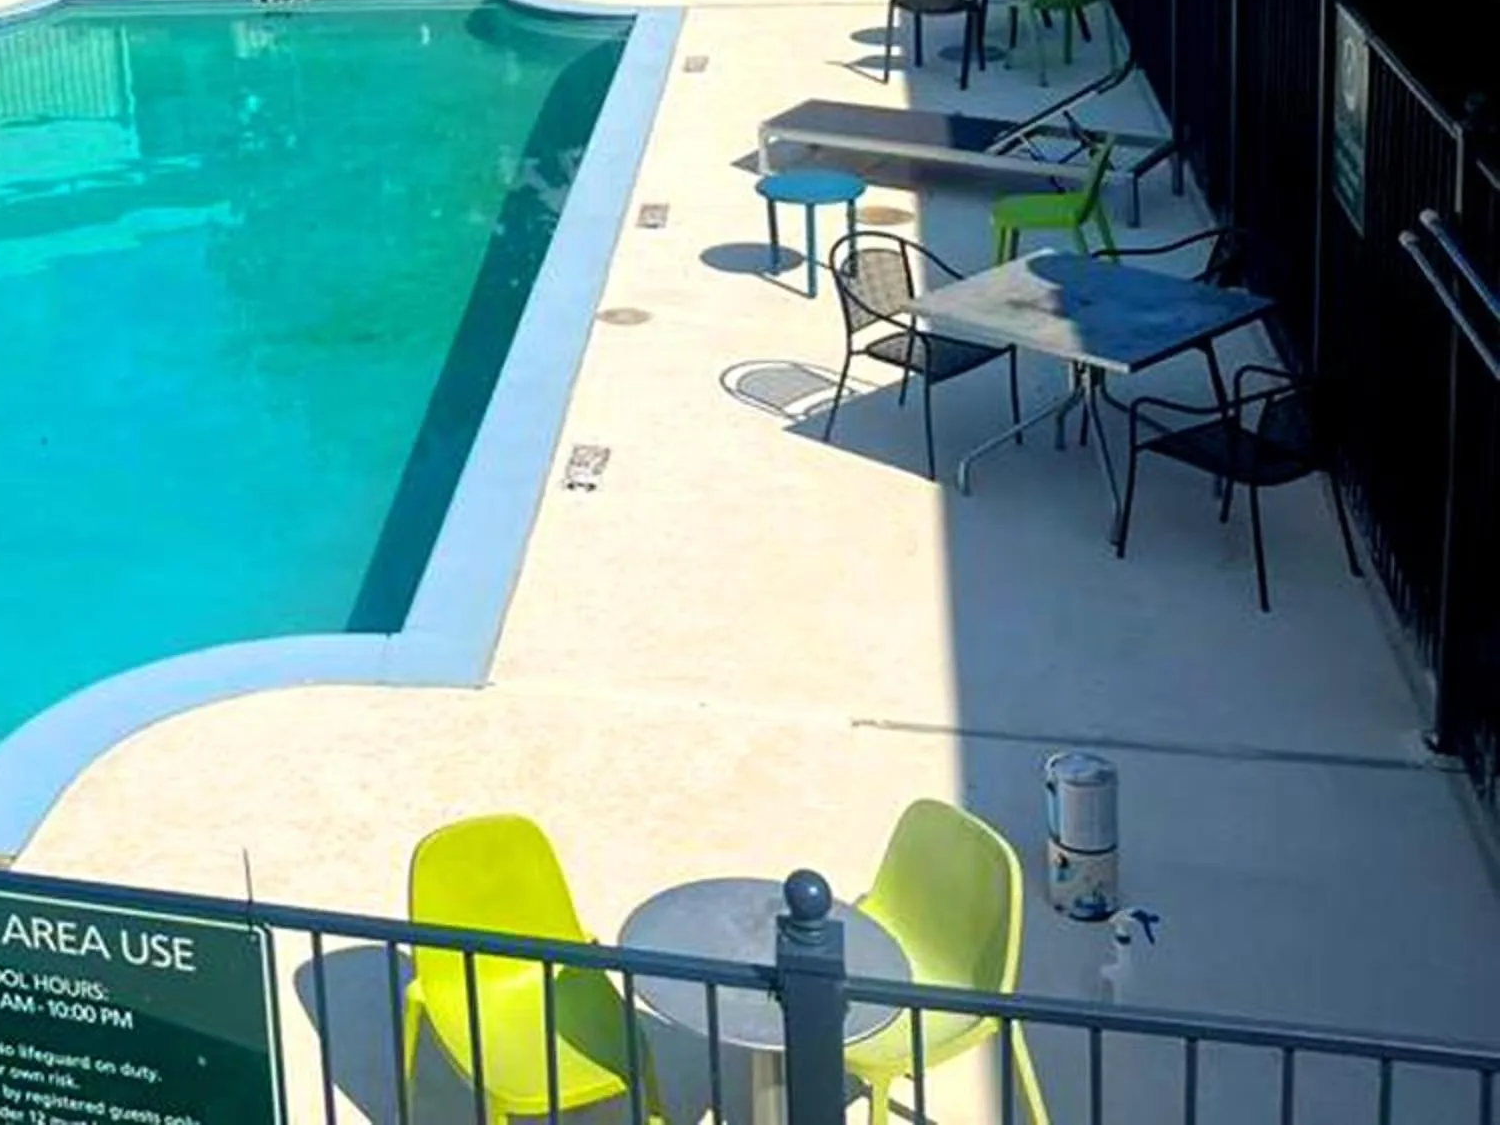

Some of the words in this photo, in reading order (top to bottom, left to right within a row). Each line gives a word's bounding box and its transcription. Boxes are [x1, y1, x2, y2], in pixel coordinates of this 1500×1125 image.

[2, 913, 112, 962] AREA
[120, 929, 197, 972] USE
[33, 974, 110, 1002] HOURS:
[0, 992, 36, 1014] AM
[47, 998, 98, 1024] 10:00
[100, 1007, 134, 1030] PM
[8, 1066, 45, 1083] own
[17, 1043, 91, 1070] lifeguard
[94, 1059, 117, 1075] on
[1, 1082, 22, 1104] by
[25, 1090, 106, 1116] registered
[108, 1105, 162, 1124] guests
